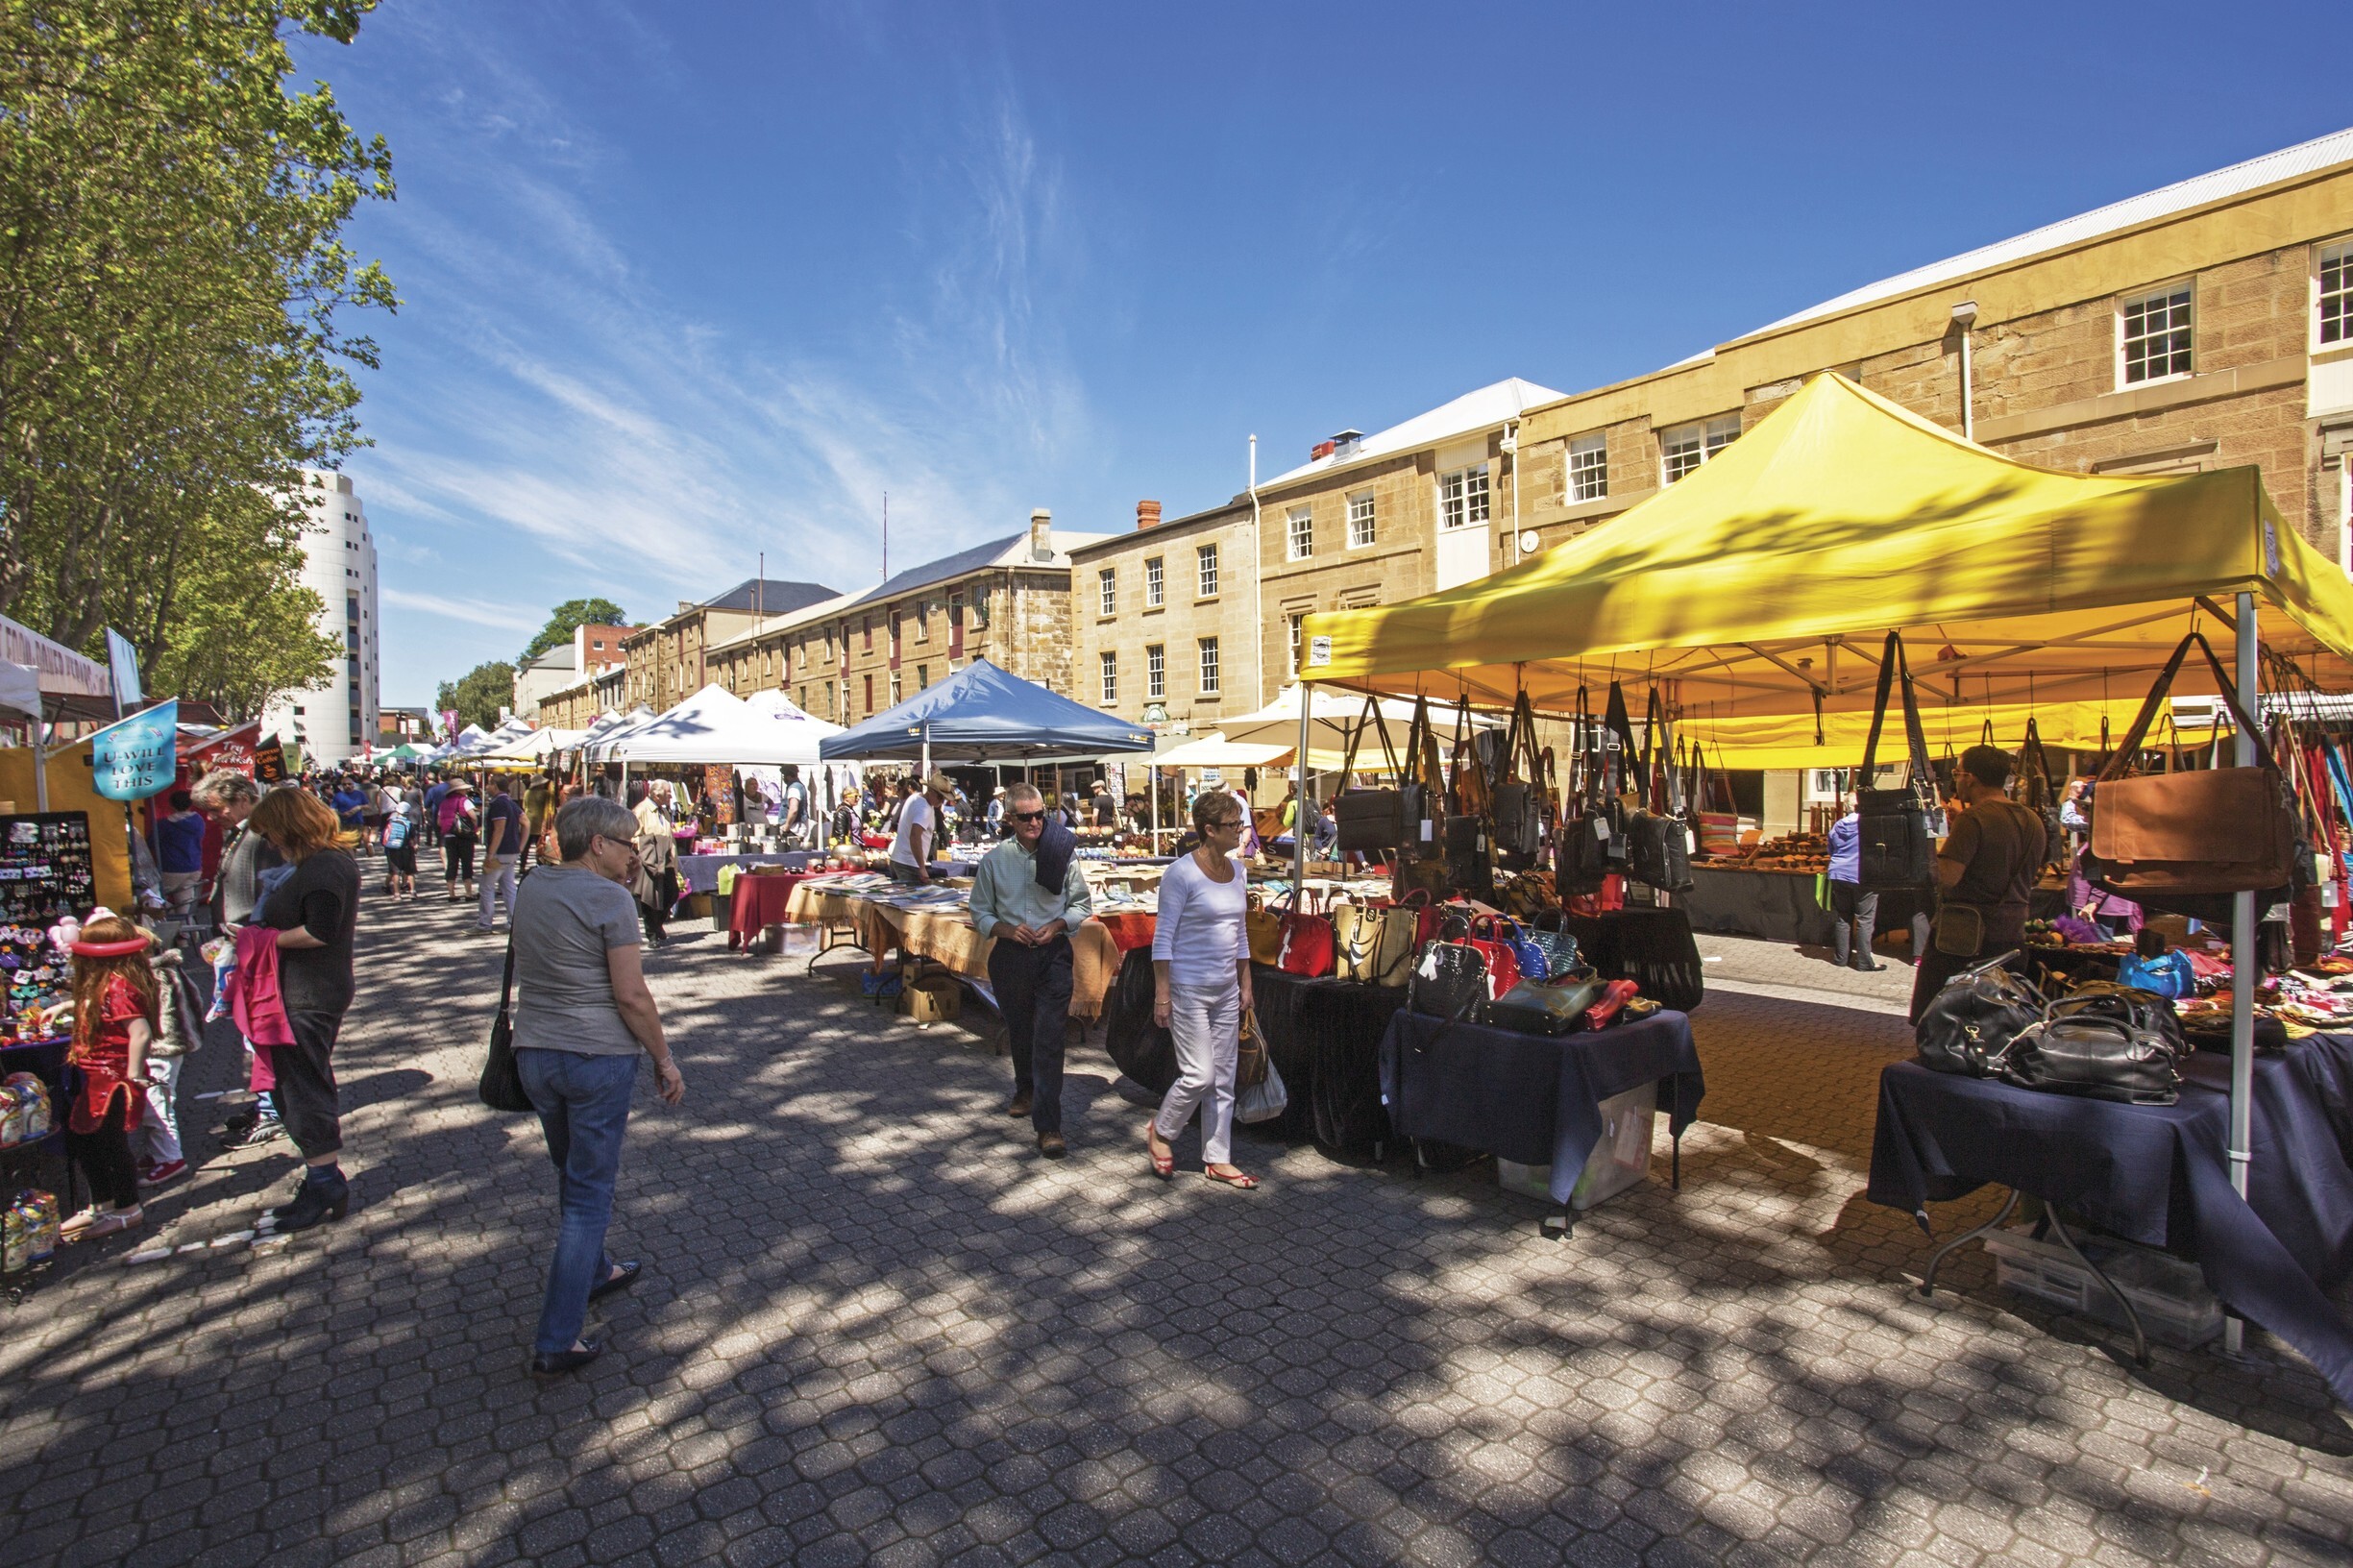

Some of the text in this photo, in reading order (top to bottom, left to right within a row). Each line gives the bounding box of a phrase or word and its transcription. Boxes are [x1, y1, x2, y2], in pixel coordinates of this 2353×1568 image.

[223, 741, 244, 754] Try
[104, 747, 165, 764] U-WILL
[111, 762, 156, 775] LOVE
[115, 775, 154, 789] THIS
